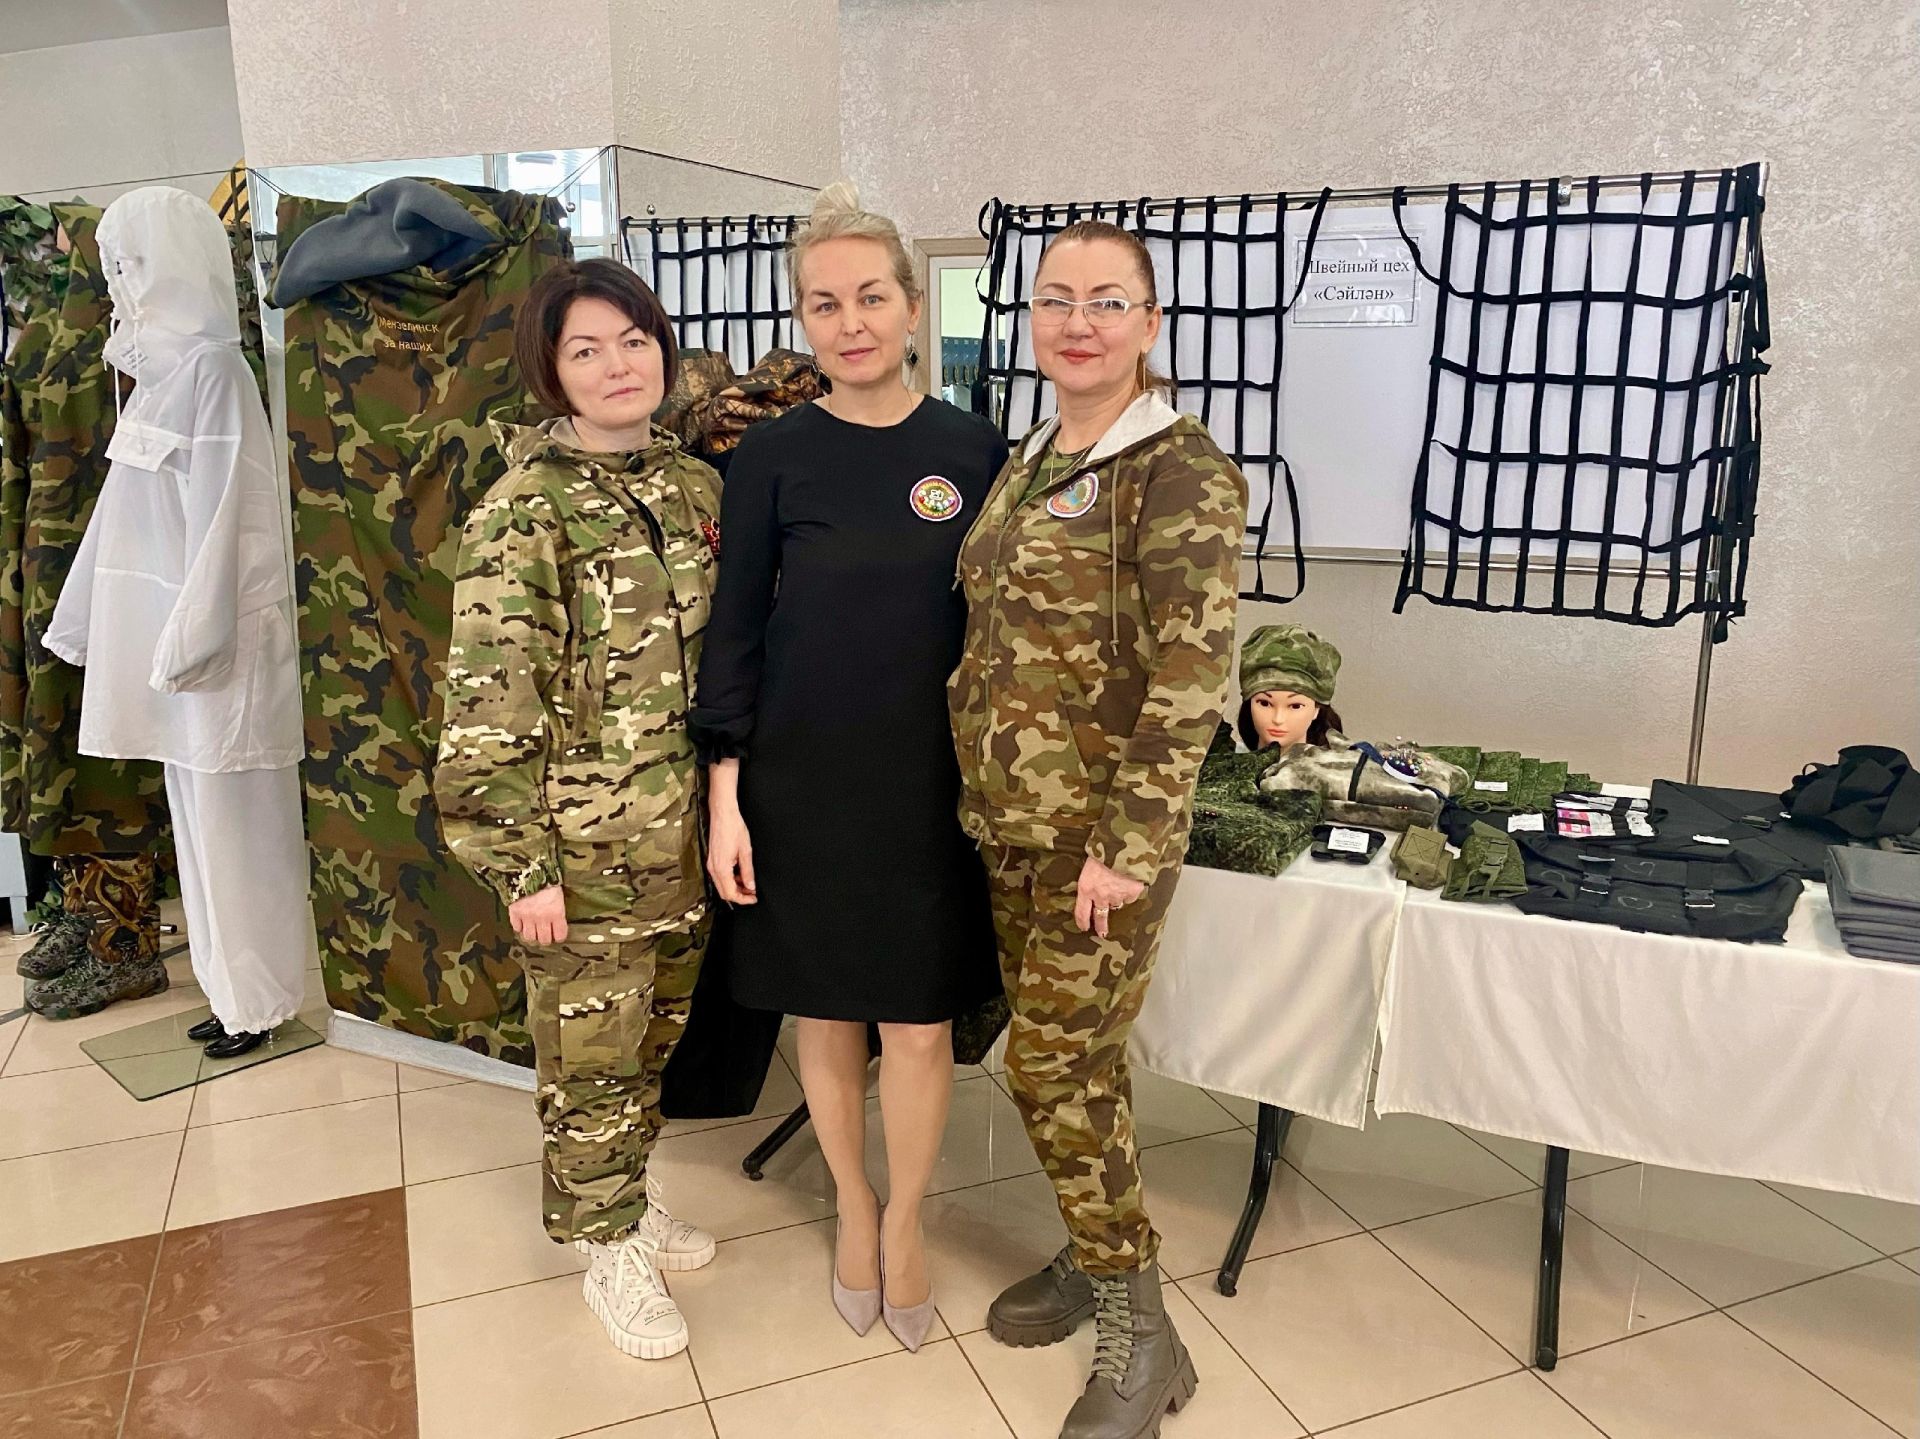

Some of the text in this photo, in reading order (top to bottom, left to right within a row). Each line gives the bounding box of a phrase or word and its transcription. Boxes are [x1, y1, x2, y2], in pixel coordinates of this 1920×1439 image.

[1384, 261, 1410, 274] цех
[1314, 285, 1394, 301] «Сәйлән»
[384, 339, 433, 352] за наших
